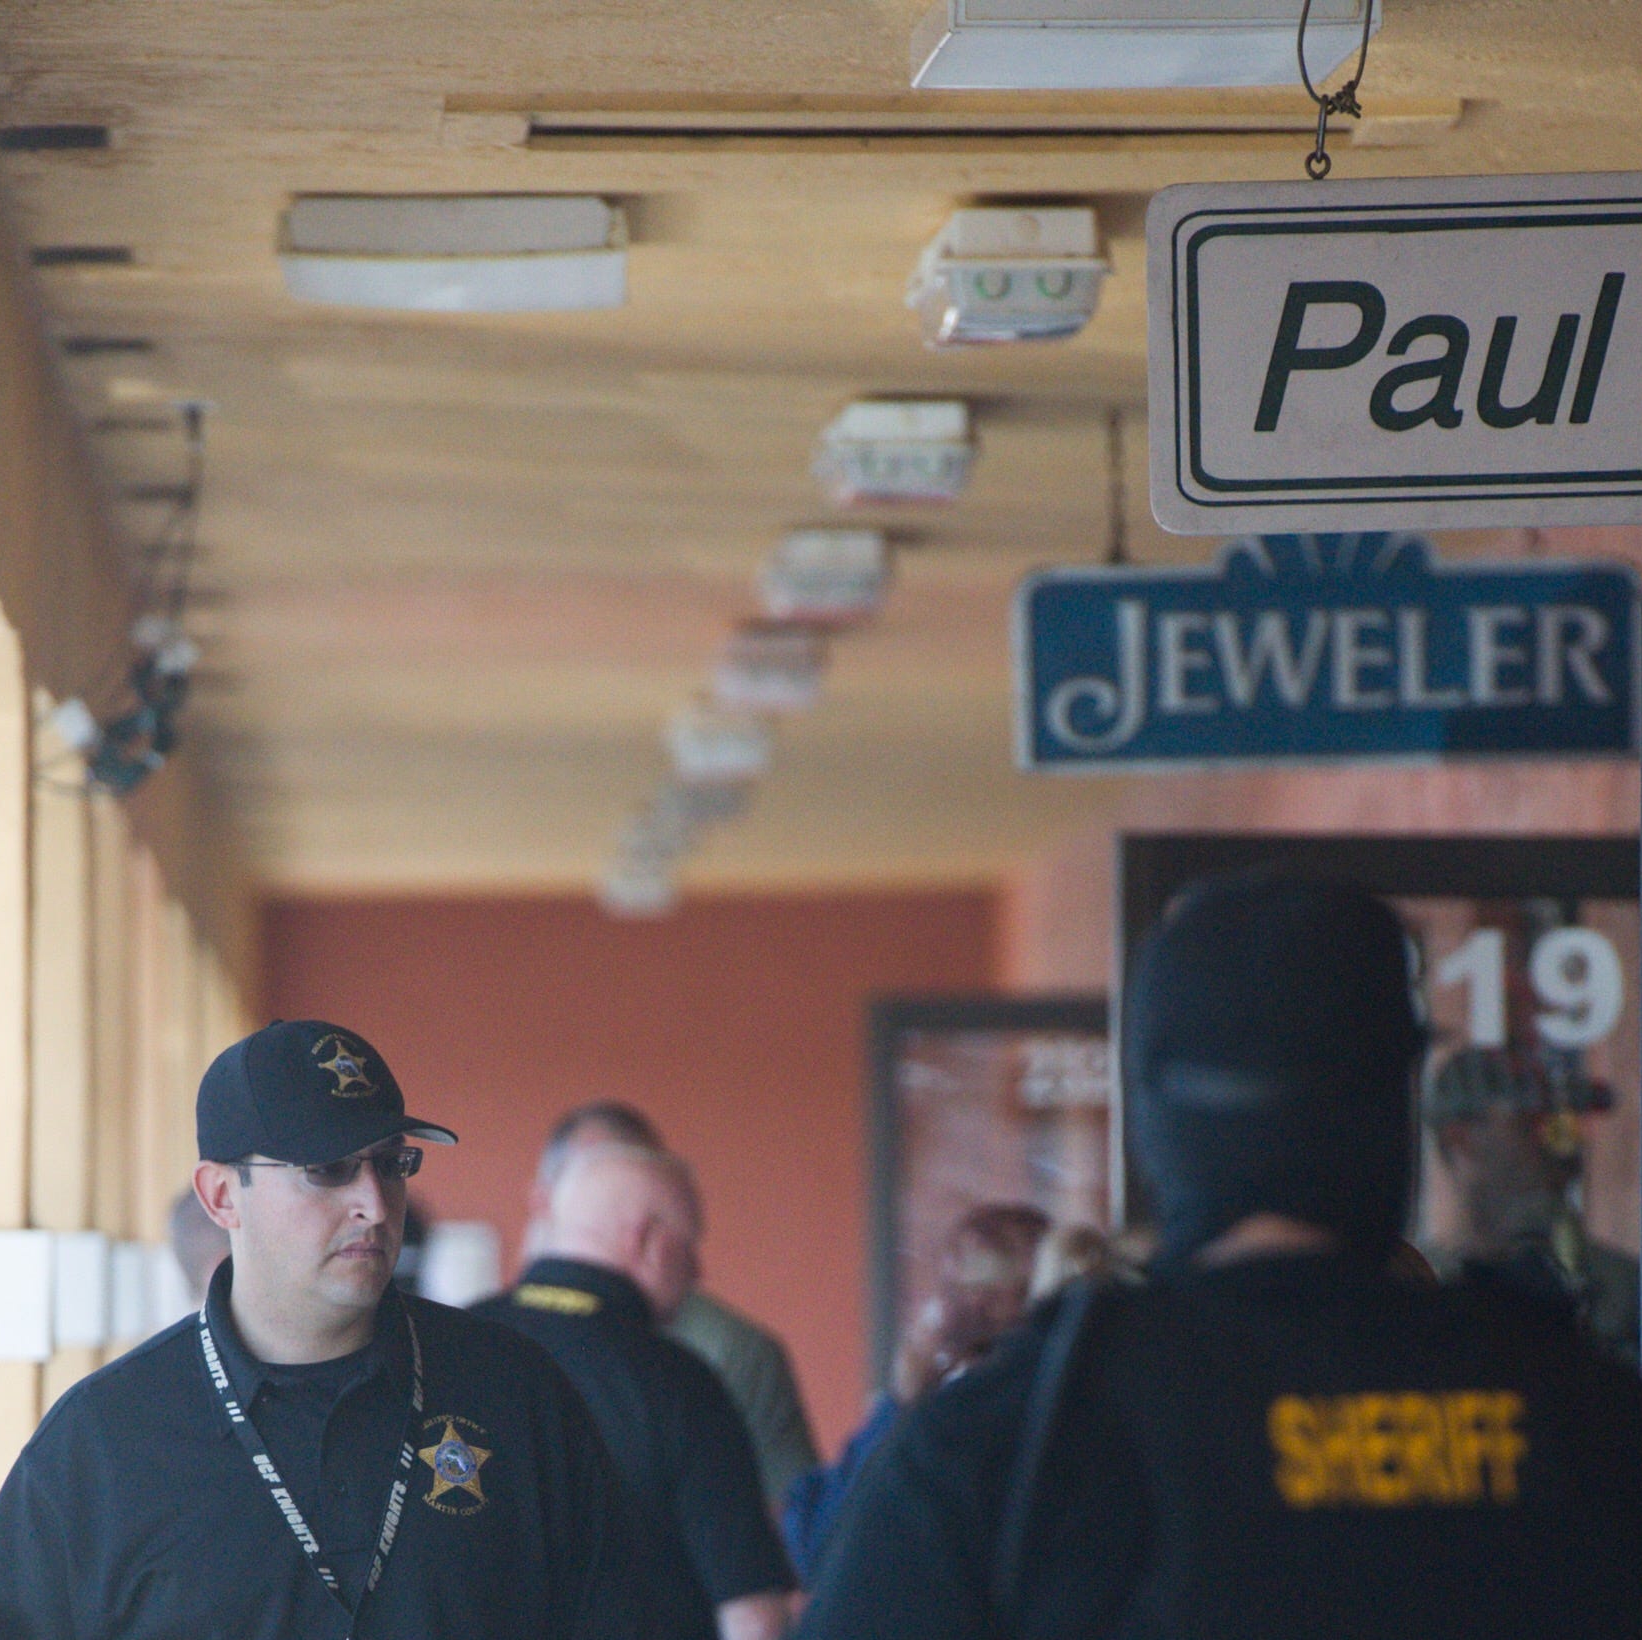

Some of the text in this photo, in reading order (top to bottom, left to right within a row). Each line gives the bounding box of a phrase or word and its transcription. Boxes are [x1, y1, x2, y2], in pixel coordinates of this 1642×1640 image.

[1254, 272, 1625, 433] Paul
[1047, 598, 1613, 752] JEWELER
[1407, 926, 1625, 1046] 19
[1267, 1391, 1529, 1508] SHERIFF
